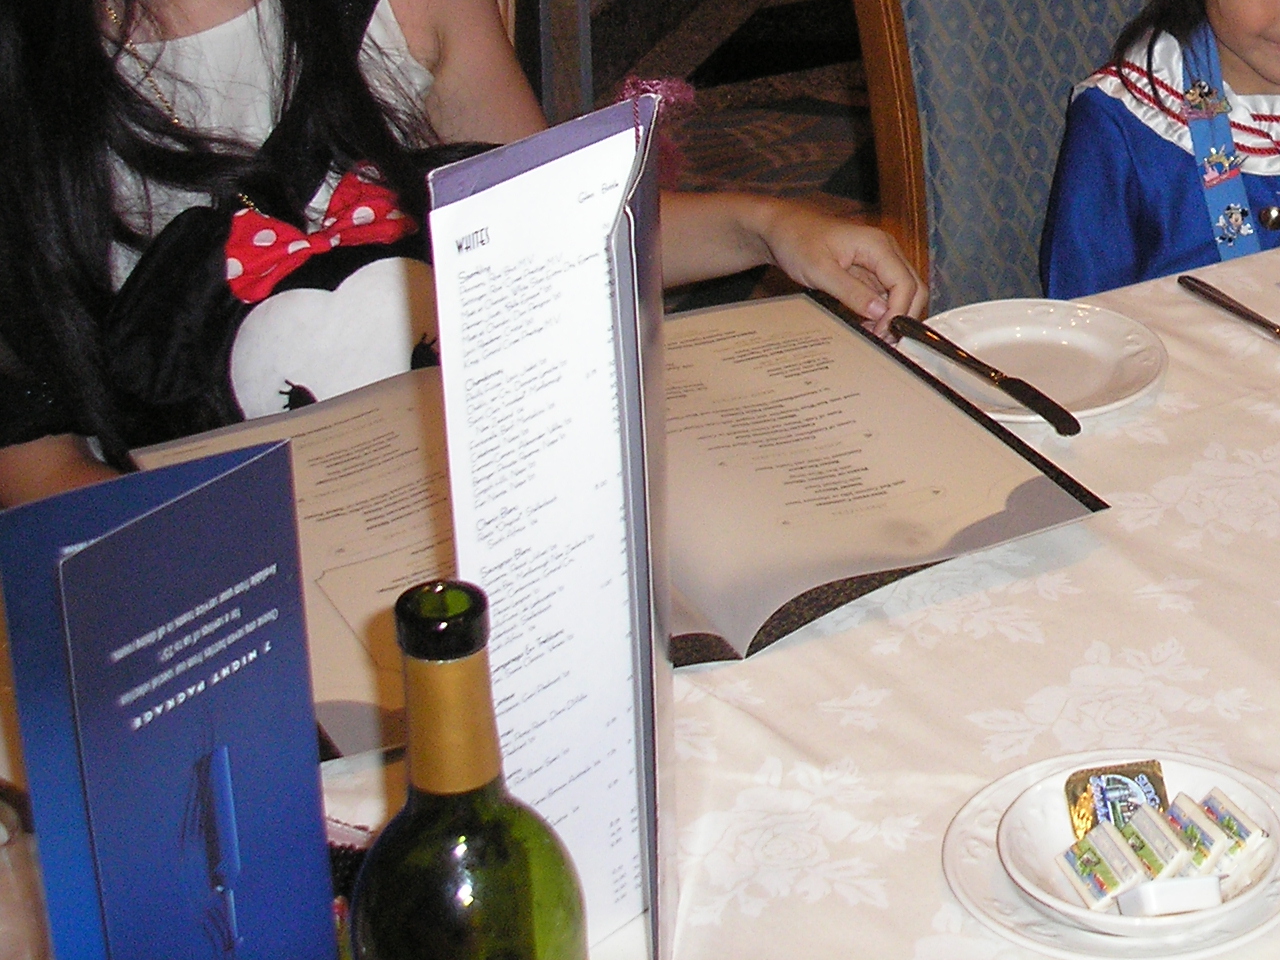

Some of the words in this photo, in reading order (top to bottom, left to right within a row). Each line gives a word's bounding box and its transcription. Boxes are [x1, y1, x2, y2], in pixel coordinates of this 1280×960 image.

[264, 641, 272, 654] 7
[211, 650, 257, 685] NIGHT
[131, 681, 206, 730] PACKAGE
